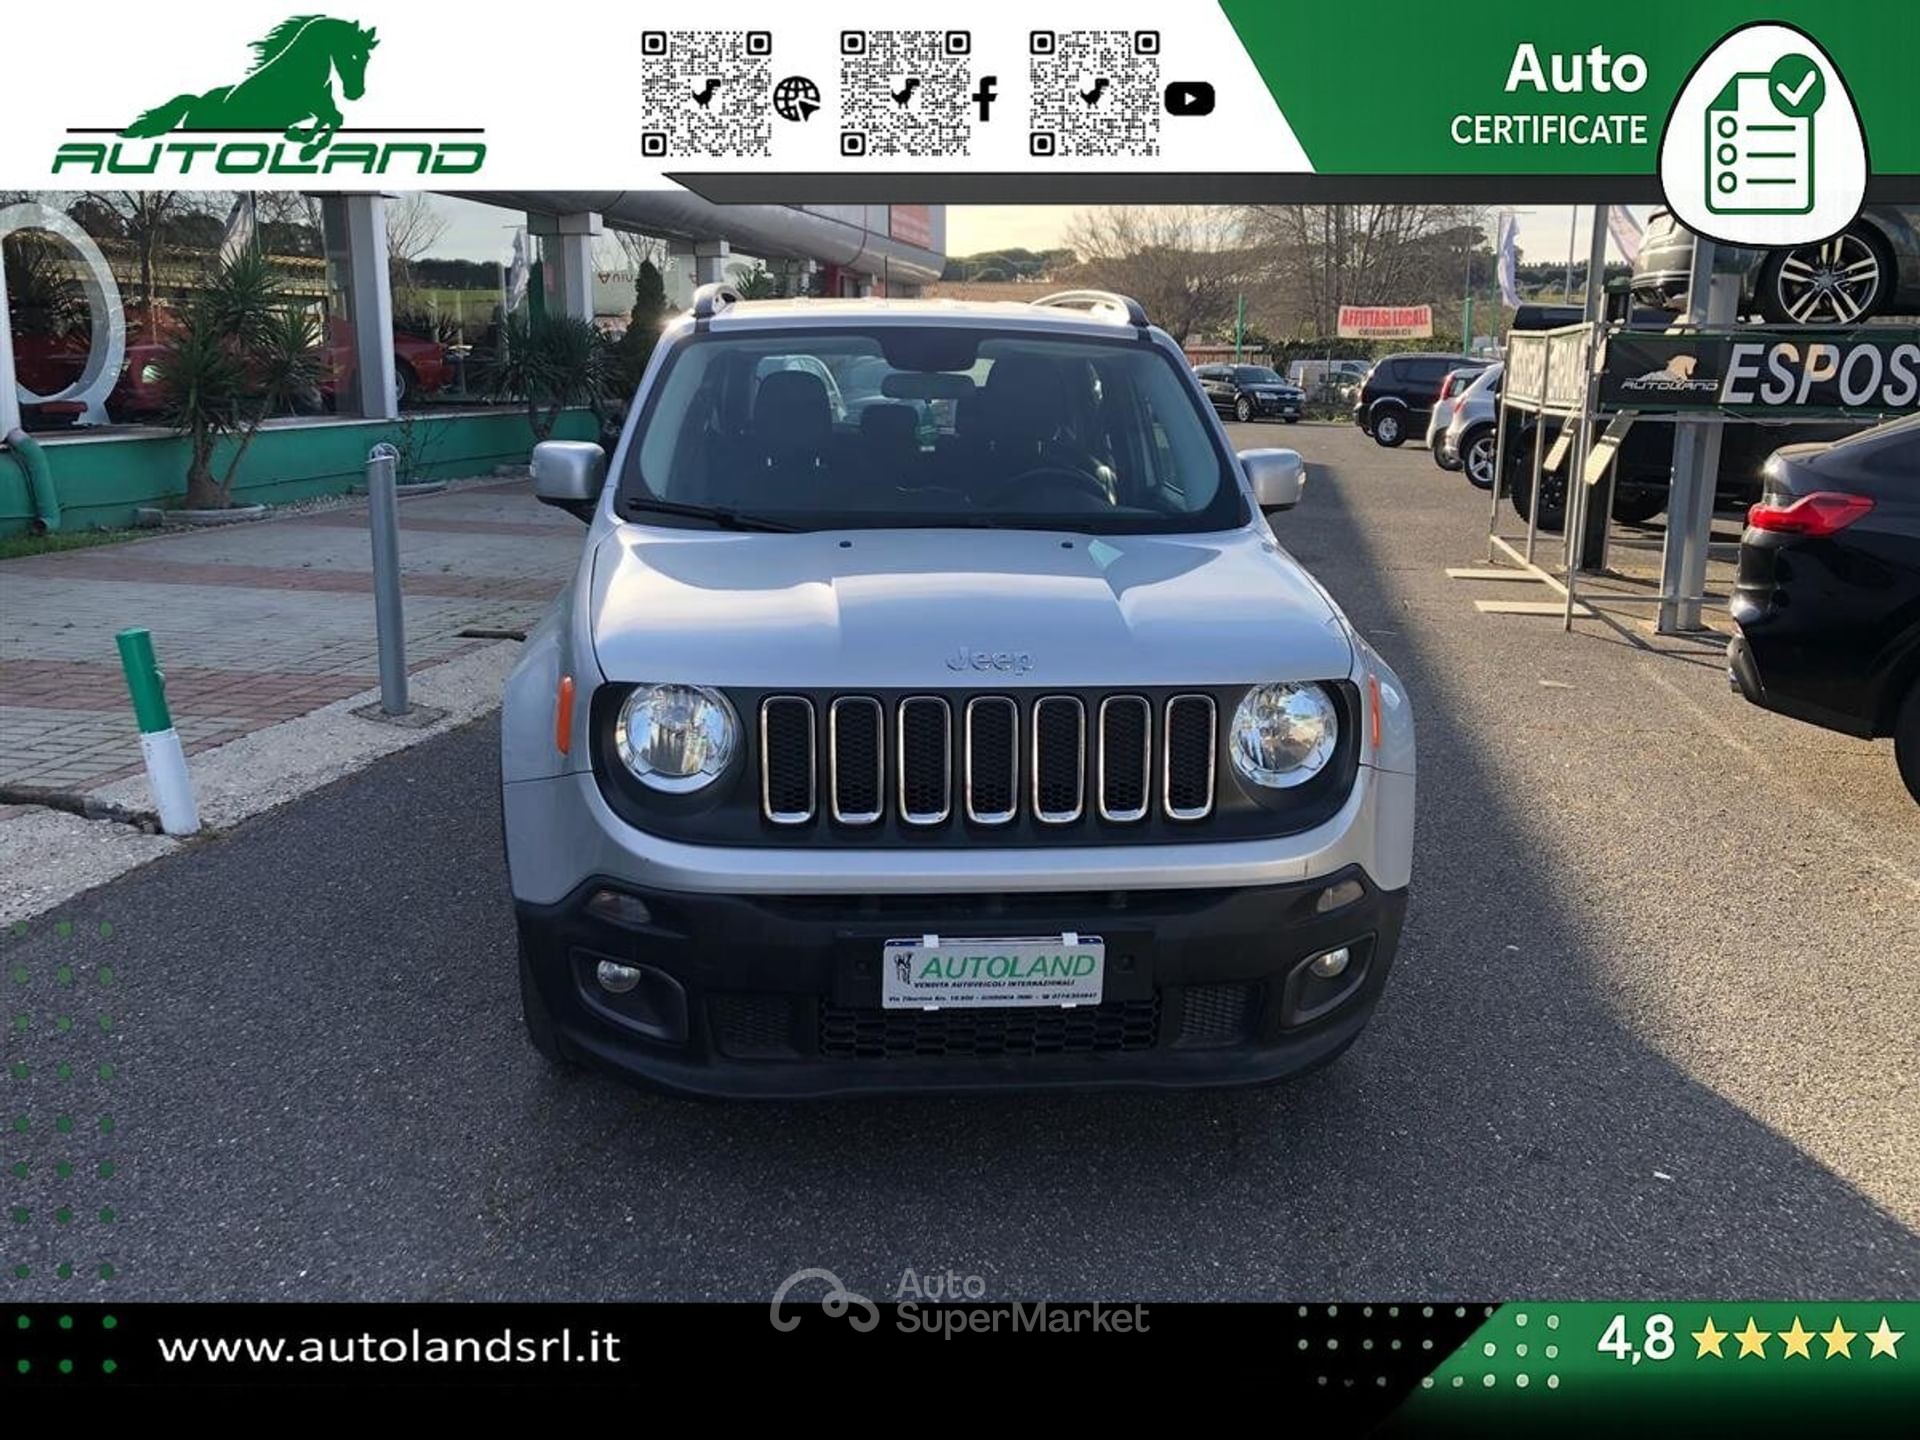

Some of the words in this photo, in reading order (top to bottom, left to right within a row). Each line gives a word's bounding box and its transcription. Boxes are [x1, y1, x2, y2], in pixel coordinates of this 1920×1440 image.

[1621, 381, 1718, 391] AUTOLAND
[1719, 343, 1920, 406] ESPOS
[945, 646, 1037, 677] Jeep
[919, 954, 1096, 979] AUTOLAND
